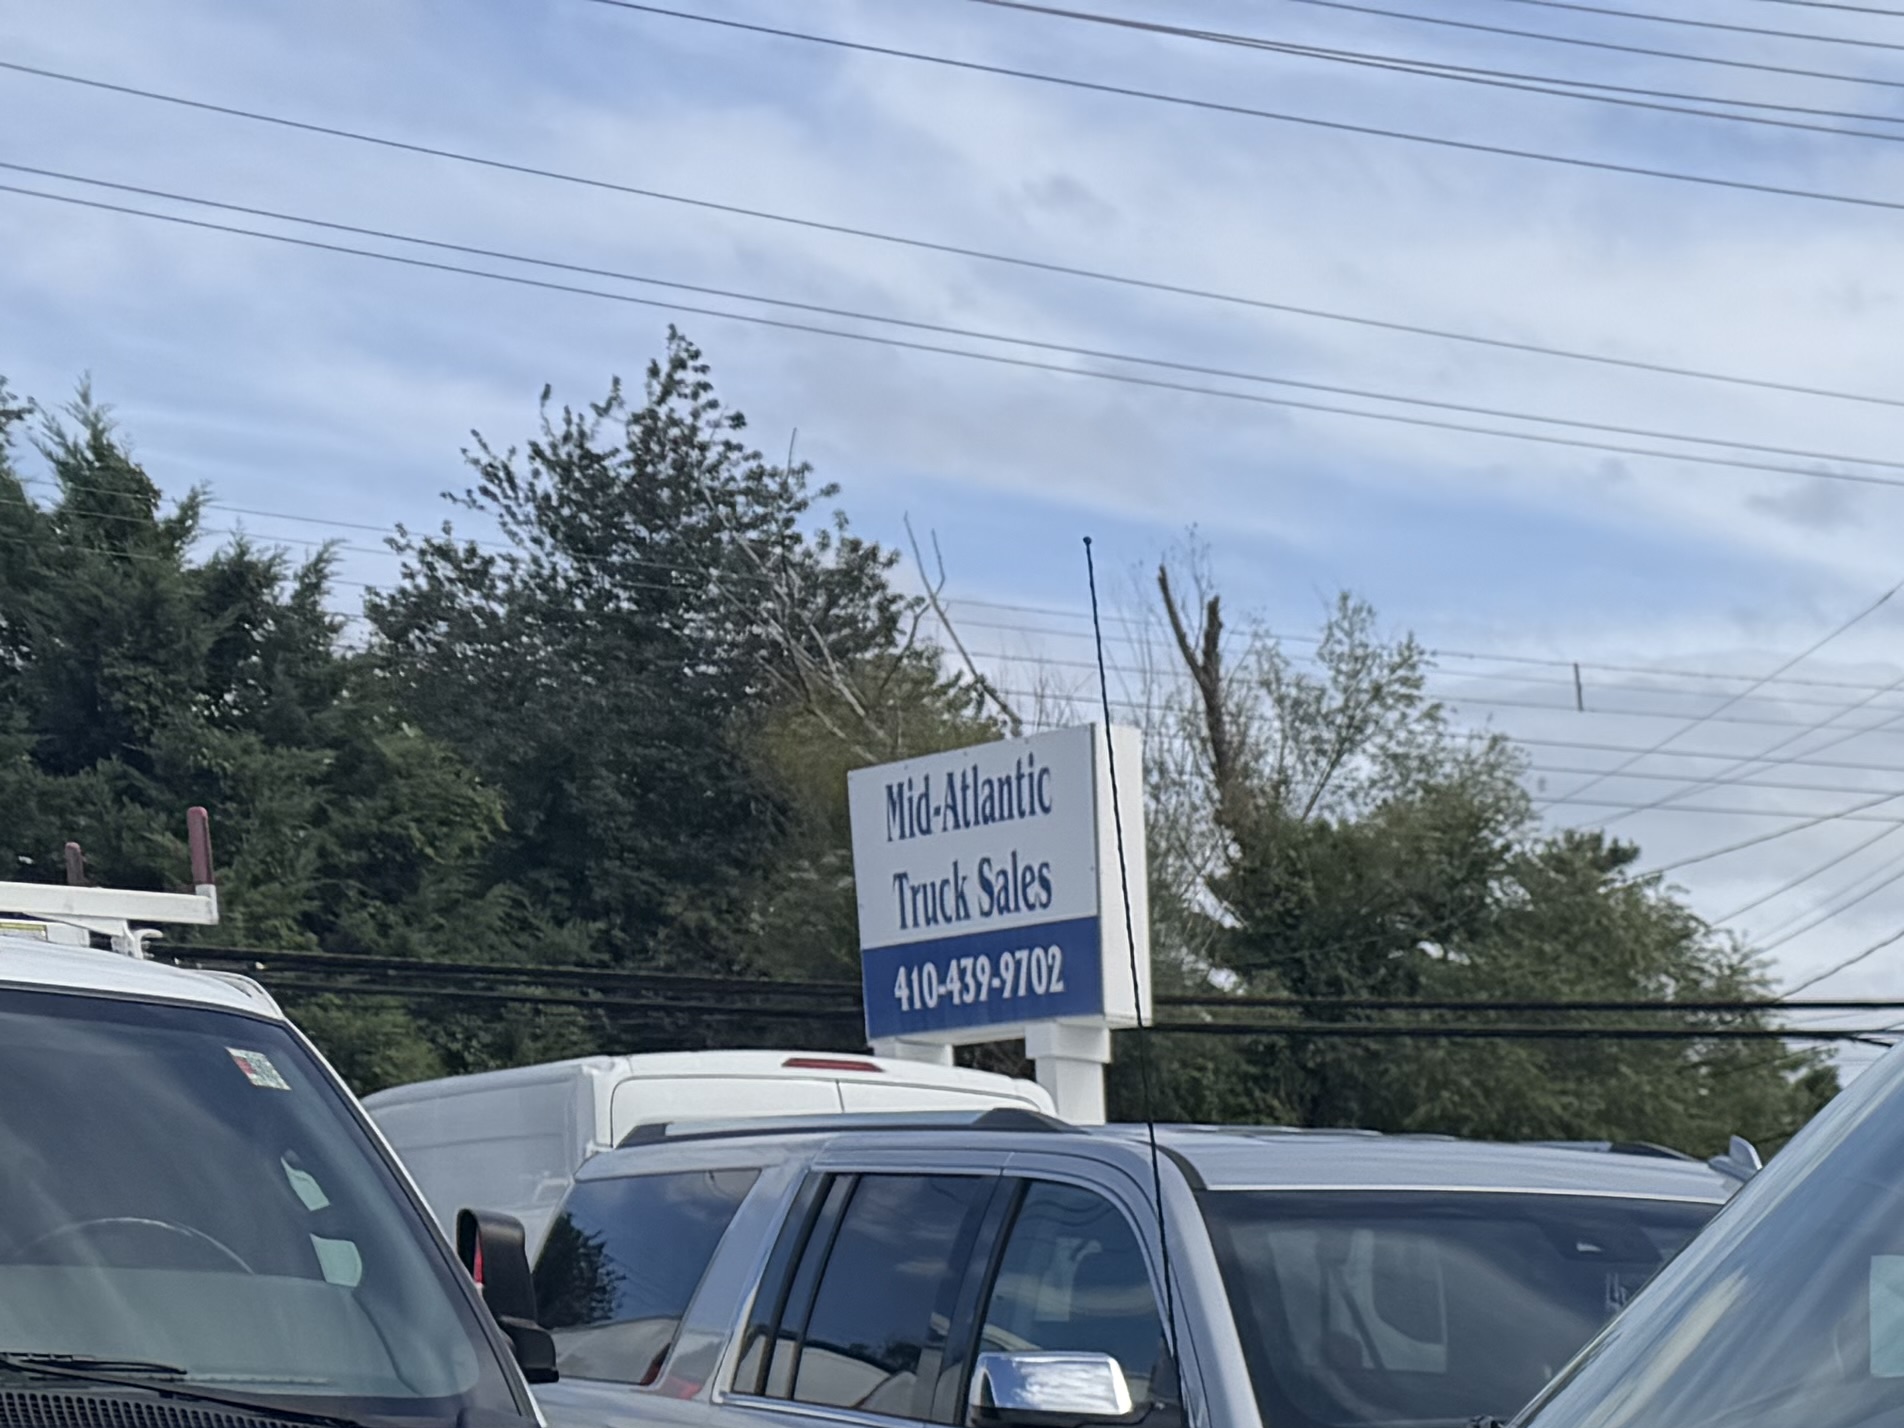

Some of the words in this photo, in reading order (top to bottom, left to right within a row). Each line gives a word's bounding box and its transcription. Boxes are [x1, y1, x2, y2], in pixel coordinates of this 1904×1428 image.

[885, 752, 1052, 842] Mid-Atlantic
[893, 860, 971, 931] Truck
[976, 850, 1053, 918] Sales
[894, 945, 1064, 1012] 410-439-9702
